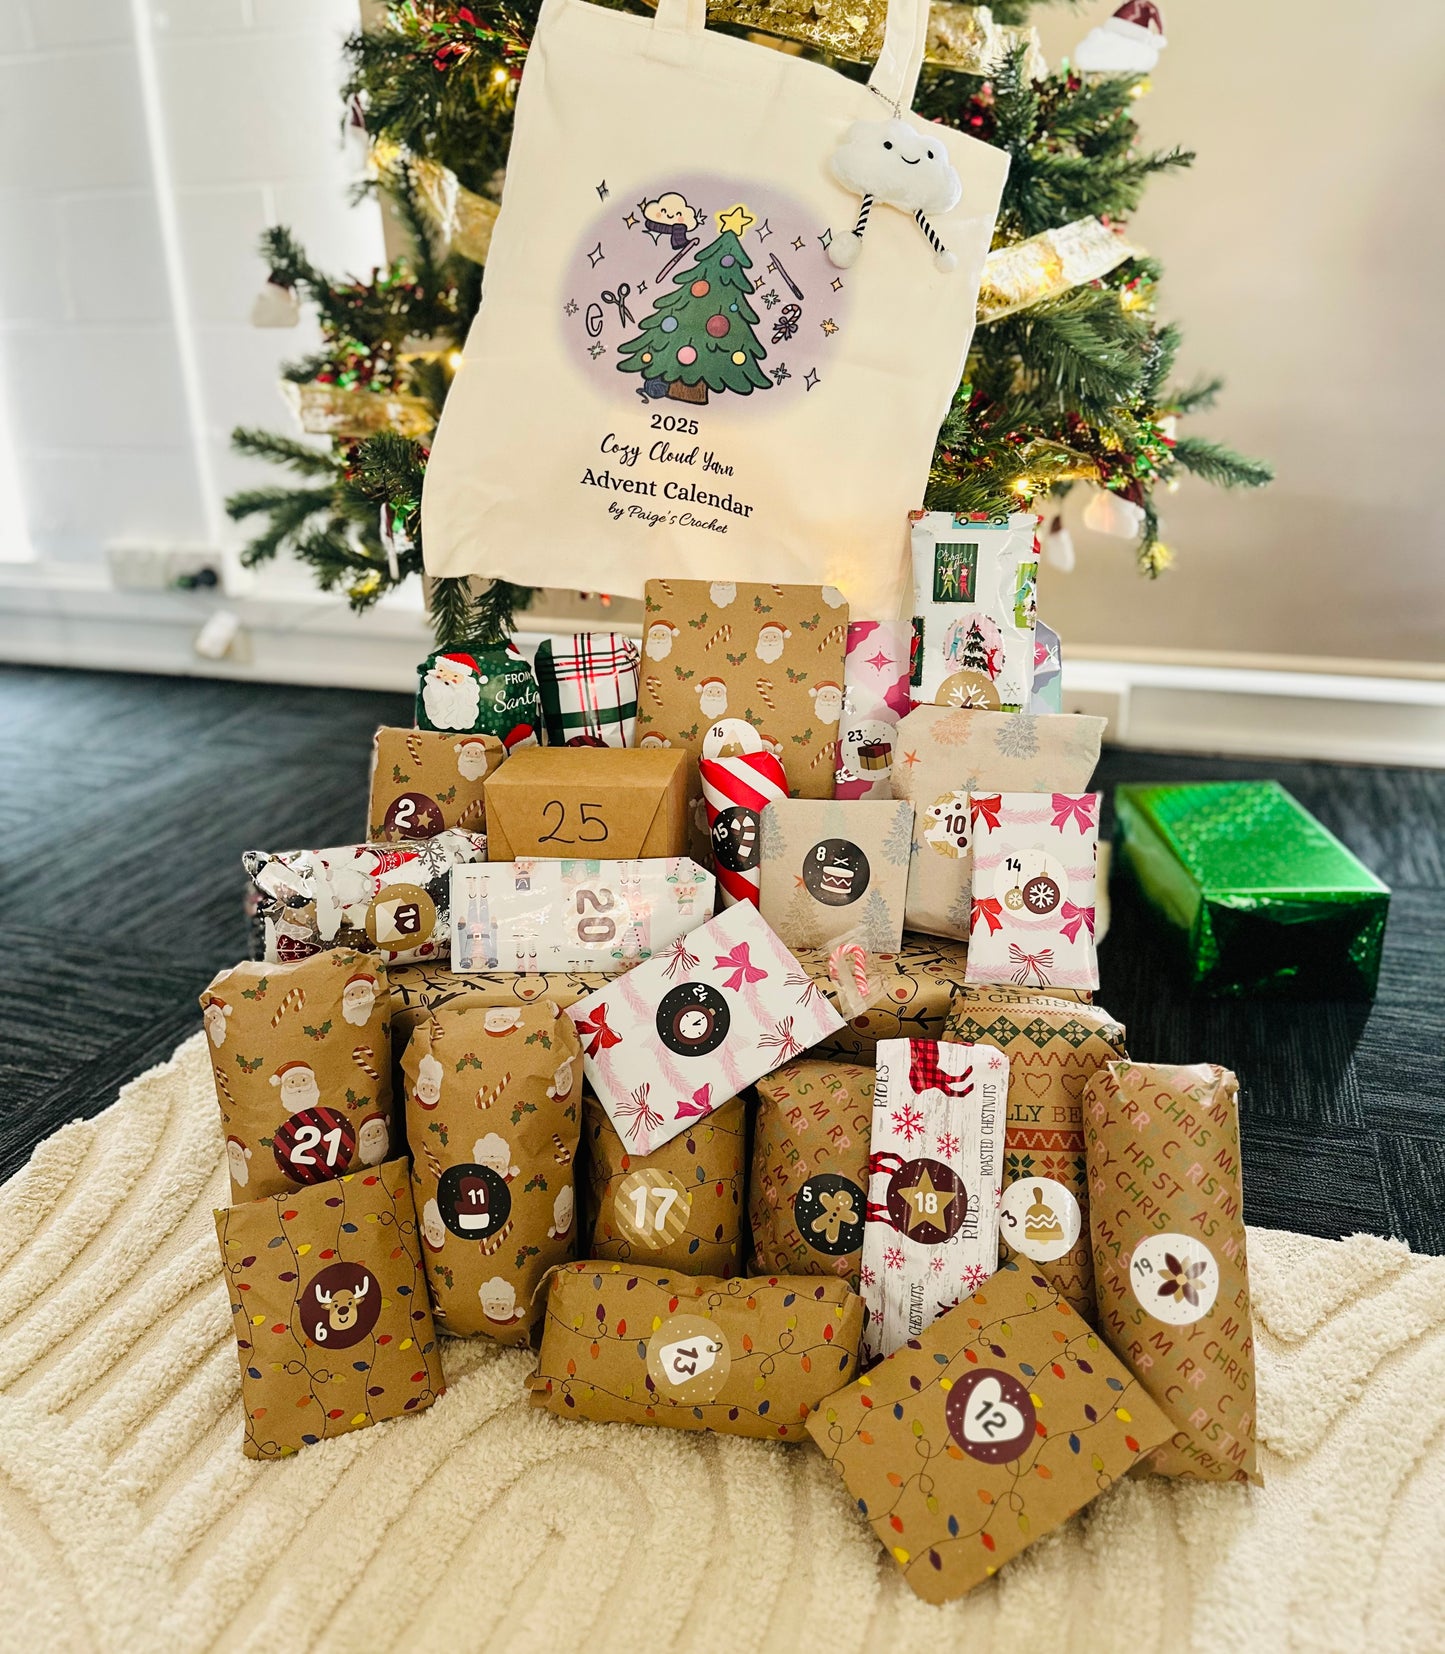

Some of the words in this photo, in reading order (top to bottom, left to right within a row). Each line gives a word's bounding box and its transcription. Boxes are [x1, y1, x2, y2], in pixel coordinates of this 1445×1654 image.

[649, 413, 700, 436] 2025
[599, 432, 642, 468] Cozy
[648, 440, 700, 467] Cloud
[701, 450, 736, 477] Yarn
[580, 467, 658, 498] Advent
[662, 481, 755, 519] Calendar
[607, 501, 625, 521] by
[627, 504, 678, 528] Paige's
[678, 511, 729, 535] Crochet
[712, 727, 724, 738] 16
[847, 729, 864, 743] 23
[393, 798, 418, 829] 2
[537, 799, 609, 844] 25
[945, 814, 967, 835] 10
[712, 822, 729, 843] 15
[815, 846, 827, 862] 8
[1005, 857, 1022, 872] 14
[576, 887, 617, 944] 20
[692, 984, 708, 1003] 24
[981, 1083, 997, 1135] CHESTNUTS
[289, 1125, 343, 1168] 21
[980, 1138, 995, 1177] ROASTED
[467, 1187, 486, 1205] 11
[802, 1185, 814, 1202] 5
[914, 1190, 938, 1215] 18
[628, 1184, 679, 1231] 17
[962, 1194, 980, 1240] RIDES
[1000, 1209, 1019, 1228] 3
[1133, 1257, 1154, 1278] 19
[908, 1282, 925, 1336] CHESTNUTS
[315, 1322, 328, 1342] 6
[673, 1346, 699, 1376] 13
[974, 1399, 1008, 1440] 12
